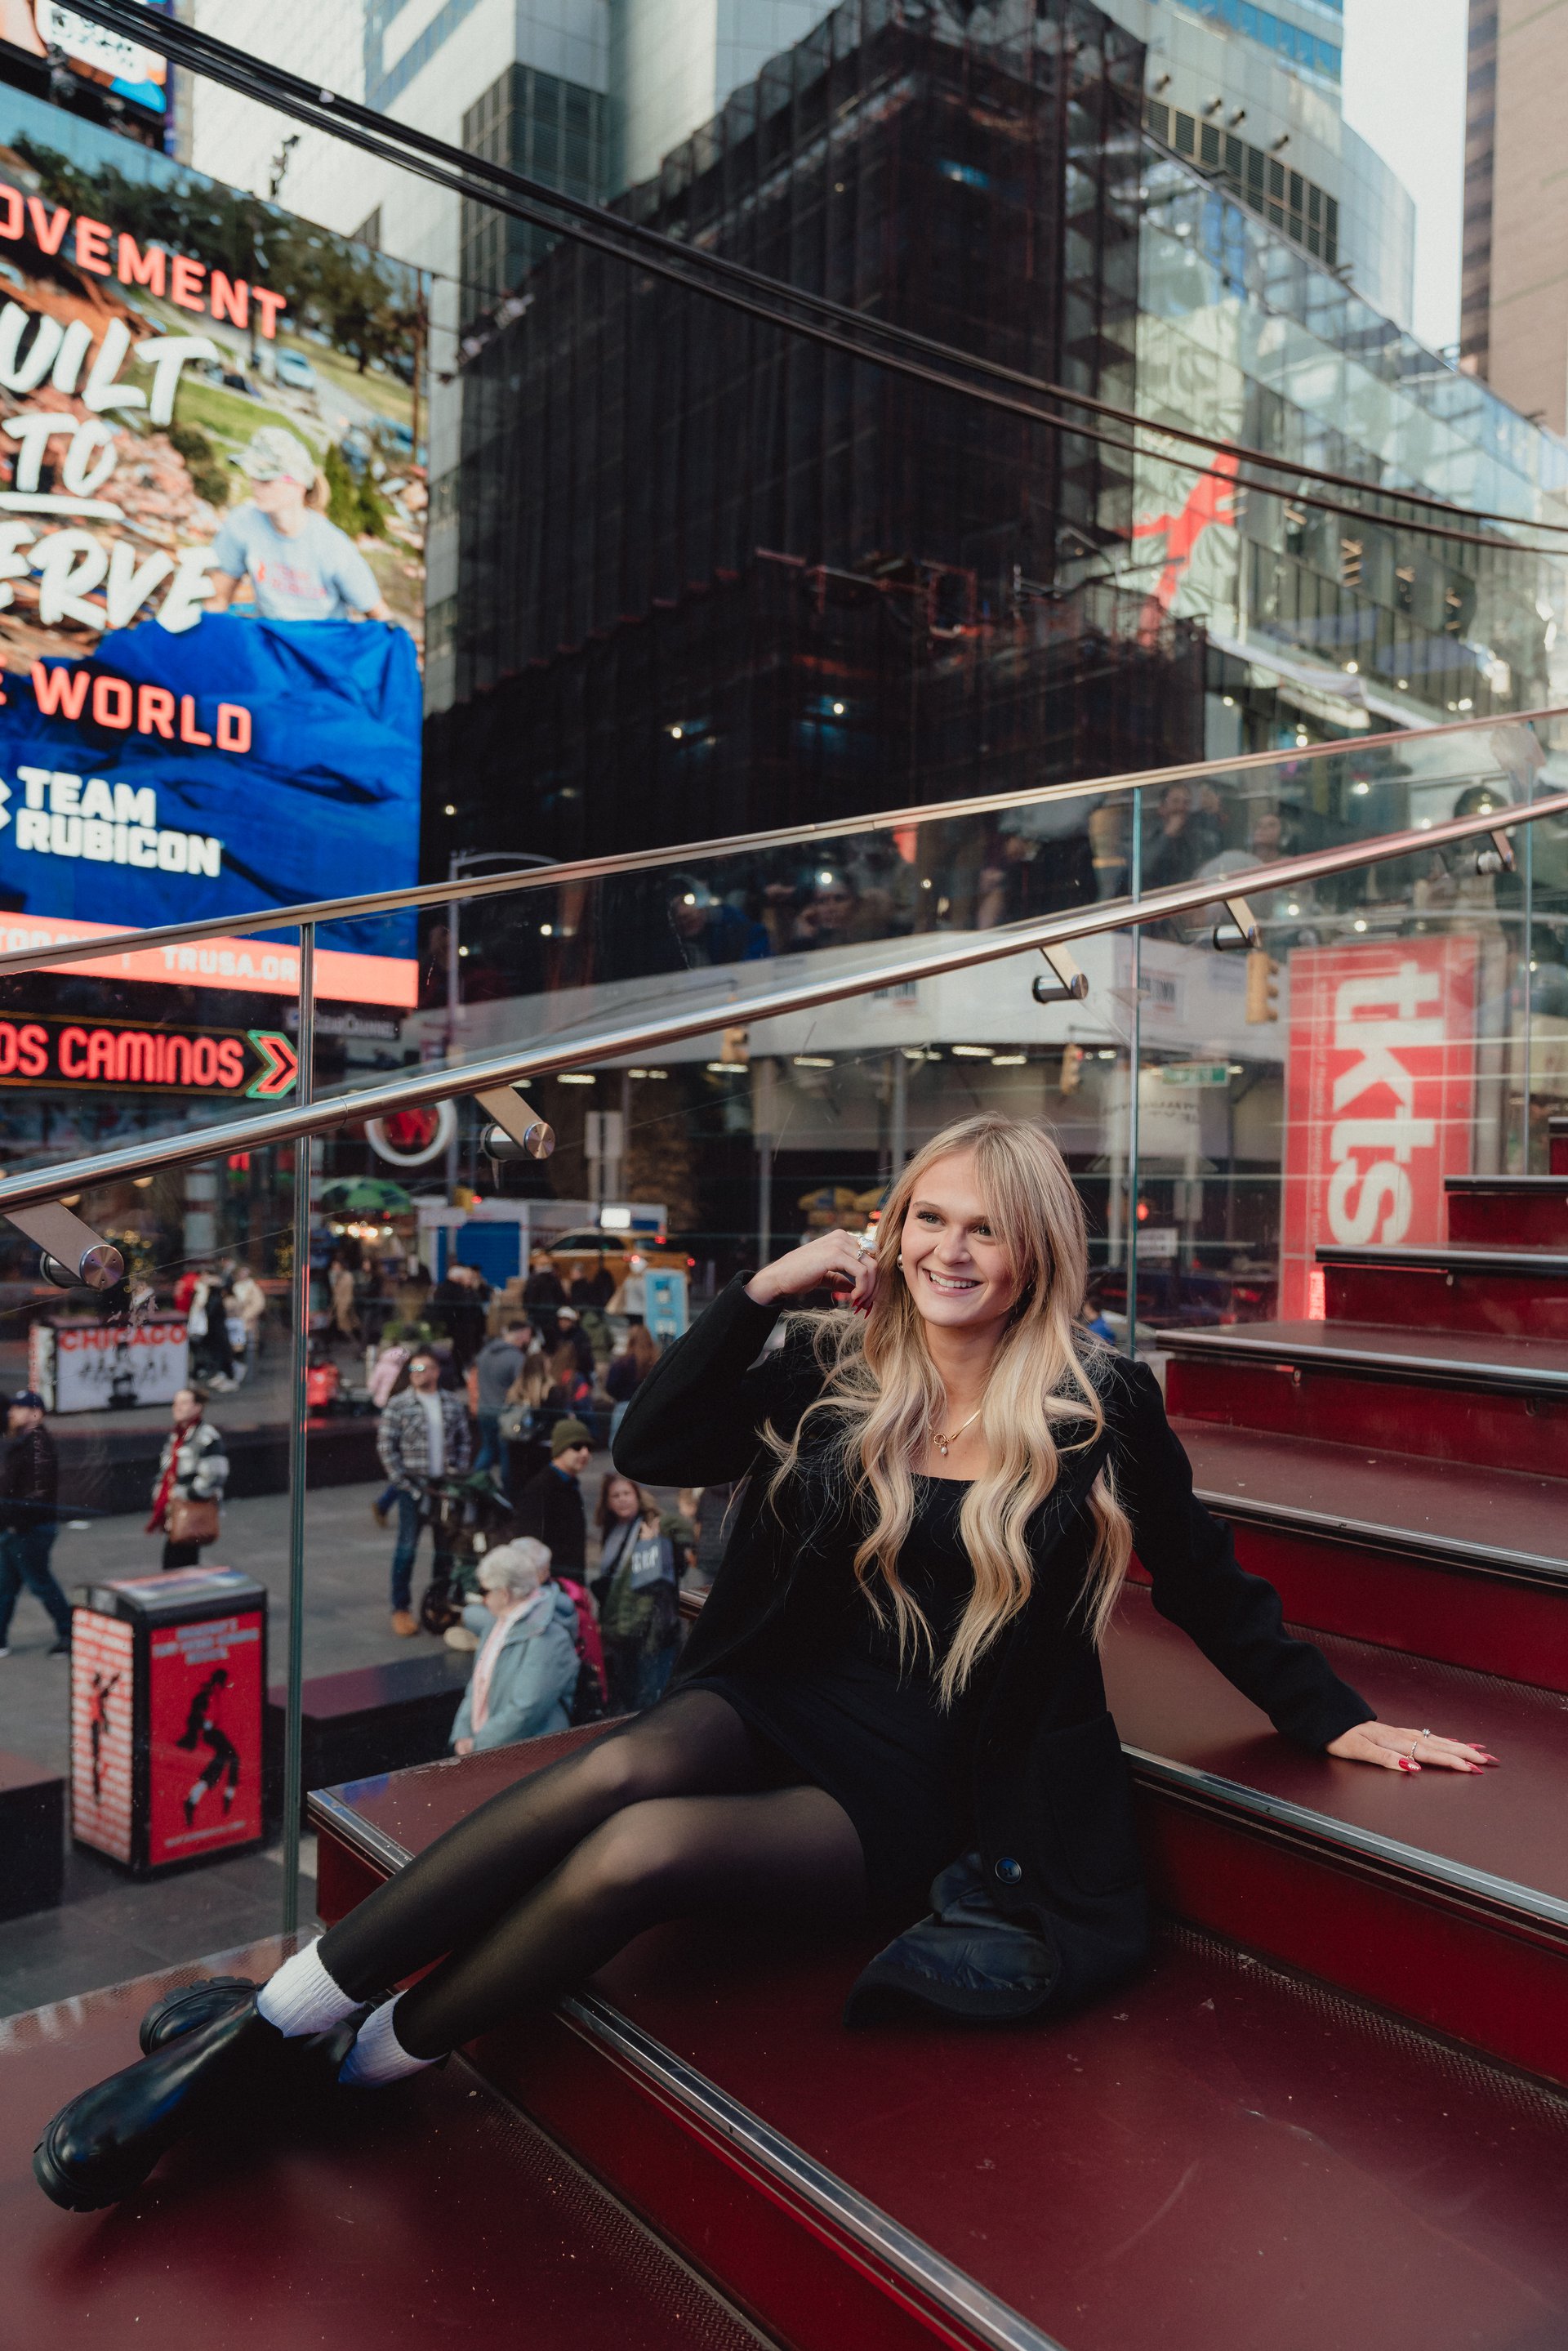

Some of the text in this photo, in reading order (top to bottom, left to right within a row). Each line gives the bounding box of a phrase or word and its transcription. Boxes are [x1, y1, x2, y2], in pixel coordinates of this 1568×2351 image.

[0, 300, 219, 425] UILT
[2, 411, 118, 497] TO
[30, 661, 252, 753] WORLD
[17, 765, 157, 828] TEAM
[16, 810, 222, 877] RUBICON
[162, 945, 317, 984] TRUSA.OR
[58, 1026, 244, 1088] CAMINOS
[1330, 961, 1445, 1246] tkts
[59, 1323, 188, 1352] CHICAGO
